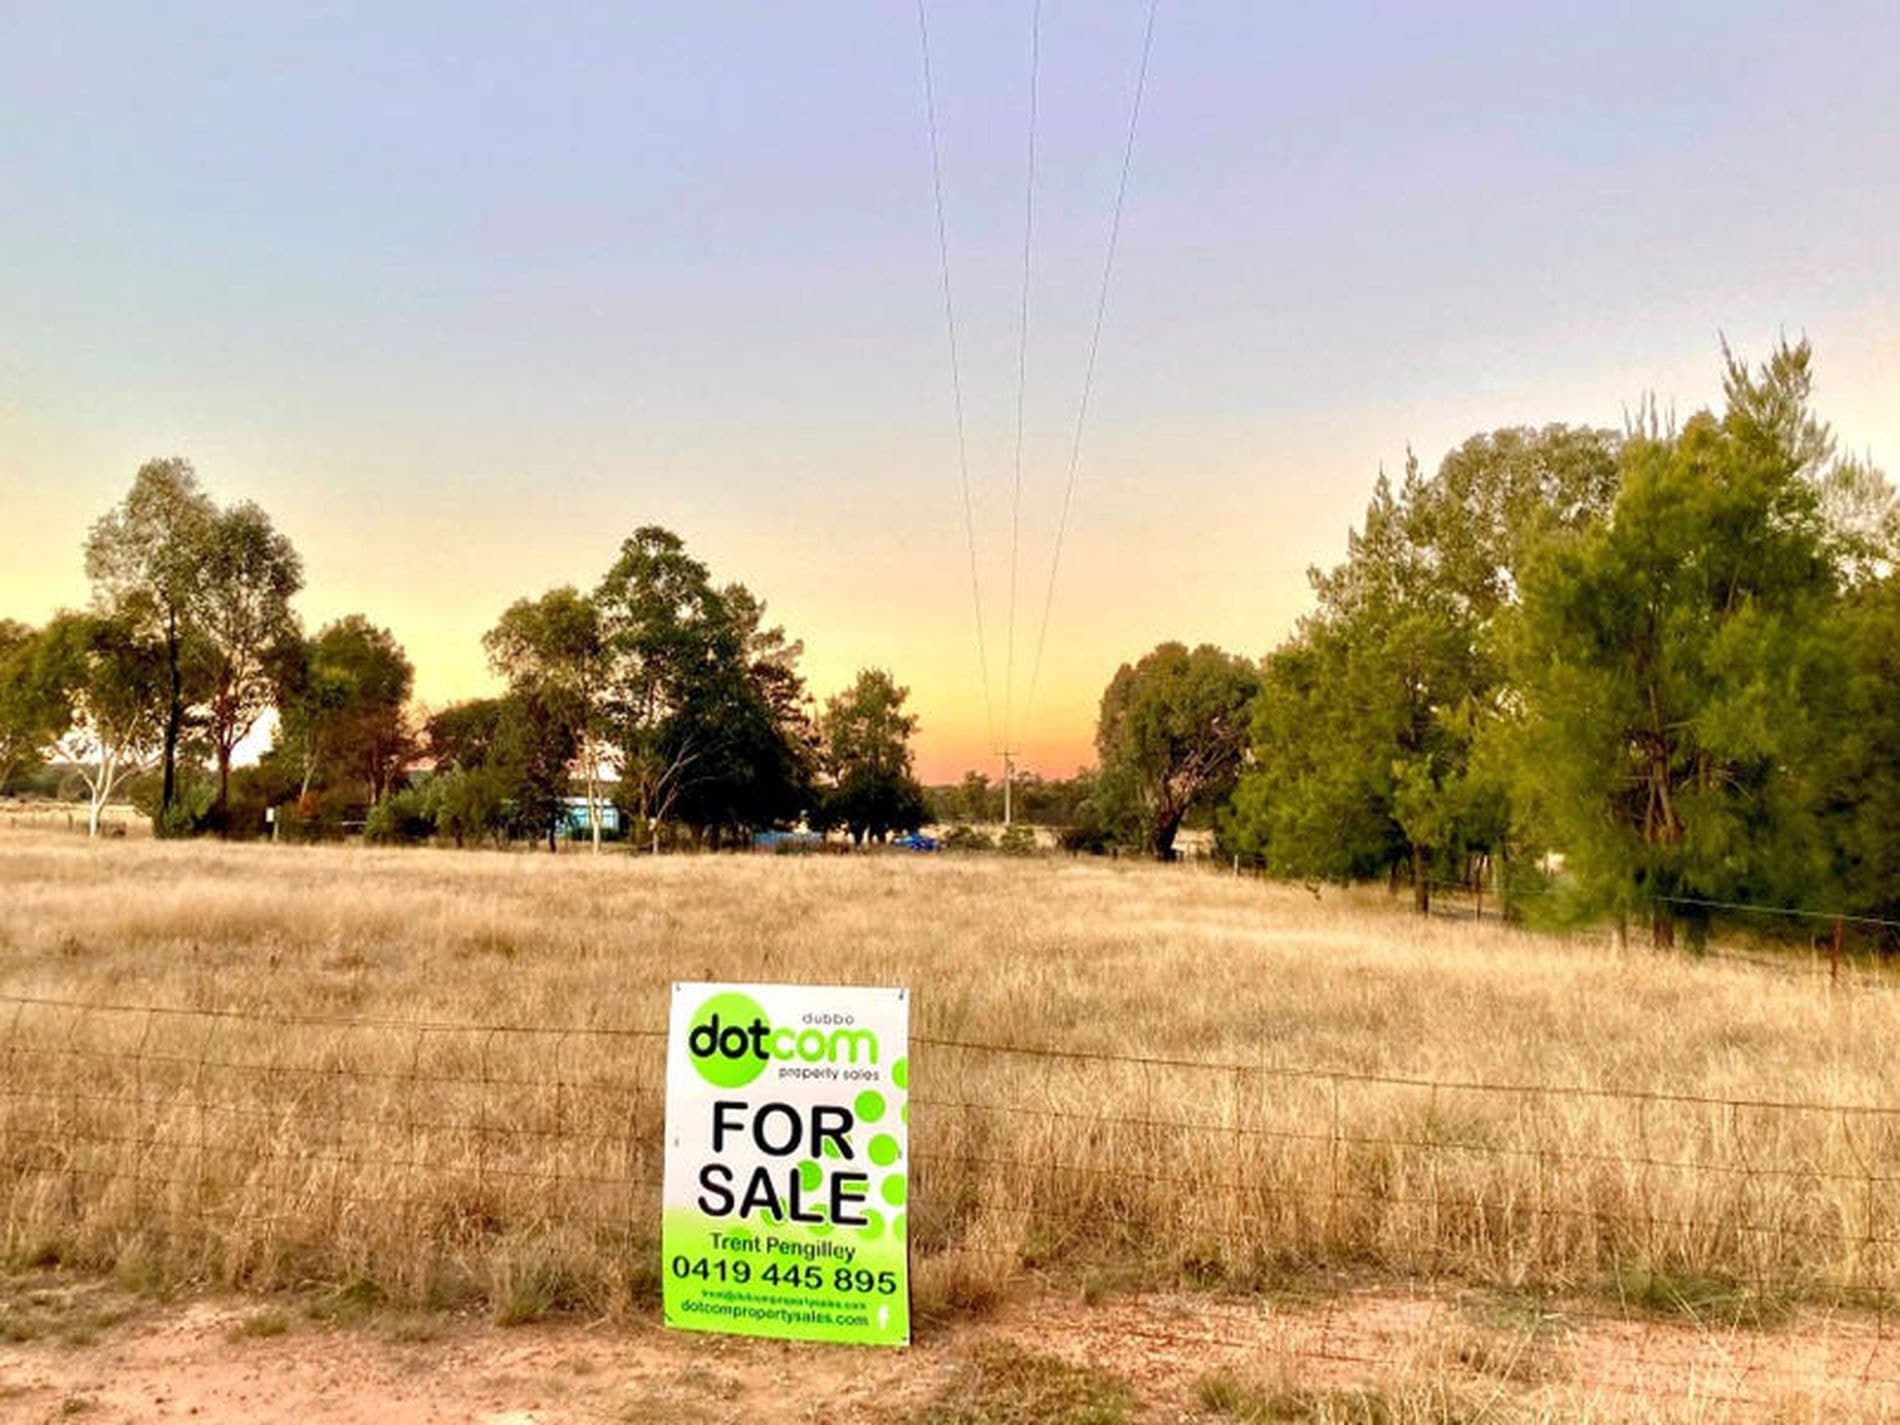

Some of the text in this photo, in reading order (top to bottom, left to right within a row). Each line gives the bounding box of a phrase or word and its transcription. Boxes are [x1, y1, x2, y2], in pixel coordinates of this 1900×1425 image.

[689, 1013, 878, 1064] dotcom
[802, 1013, 855, 1025] dubbo
[778, 1067, 880, 1082] property sales
[712, 1100, 855, 1160] FOR
[698, 1164, 868, 1226] SALE
[710, 1232, 856, 1263] Trent Pengilley
[672, 1255, 897, 1296] 0419 445 895
